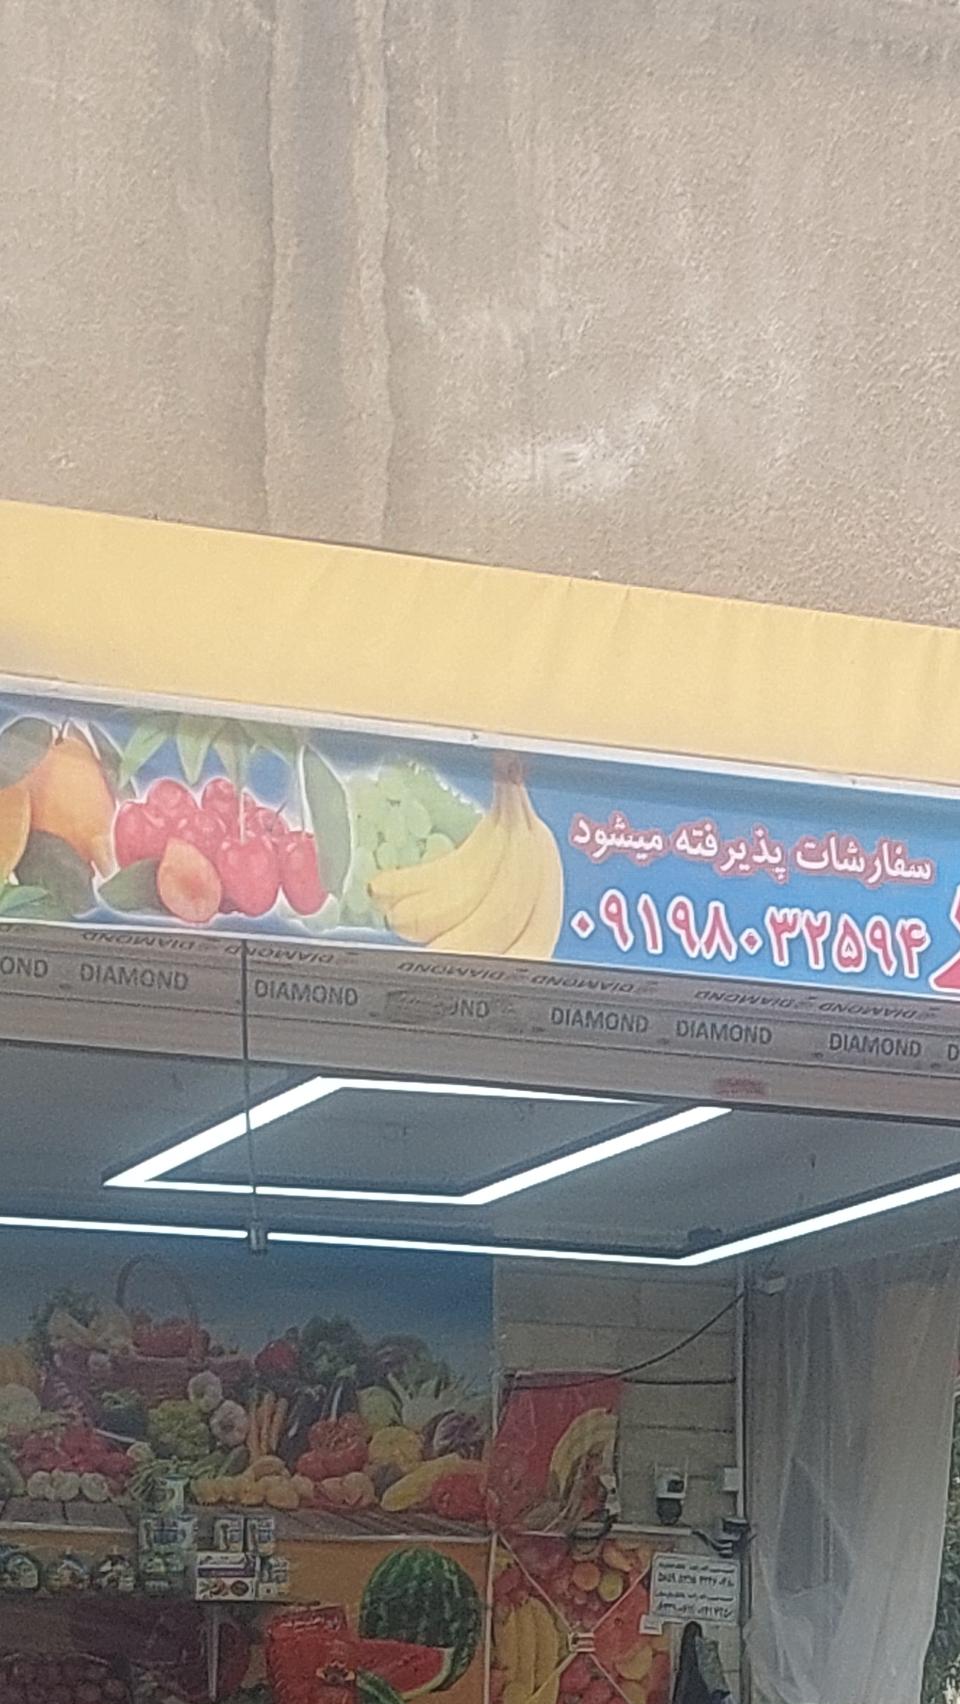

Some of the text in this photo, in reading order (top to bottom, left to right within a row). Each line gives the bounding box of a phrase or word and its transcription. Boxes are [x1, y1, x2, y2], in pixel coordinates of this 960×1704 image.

[572, 814, 934, 884] سفارشات پذیرفته میشود
[570, 888, 931, 978] ۰۹۱۹۸۰۳۲۵۹۴
[80, 962, 189, 992] DIAMOND
[254, 978, 358, 1007] DIAMOND
[550, 1006, 650, 1034] DIAMOND
[675, 1018, 773, 1046] DIAMOND
[828, 1032, 922, 1058] DIAMOND
